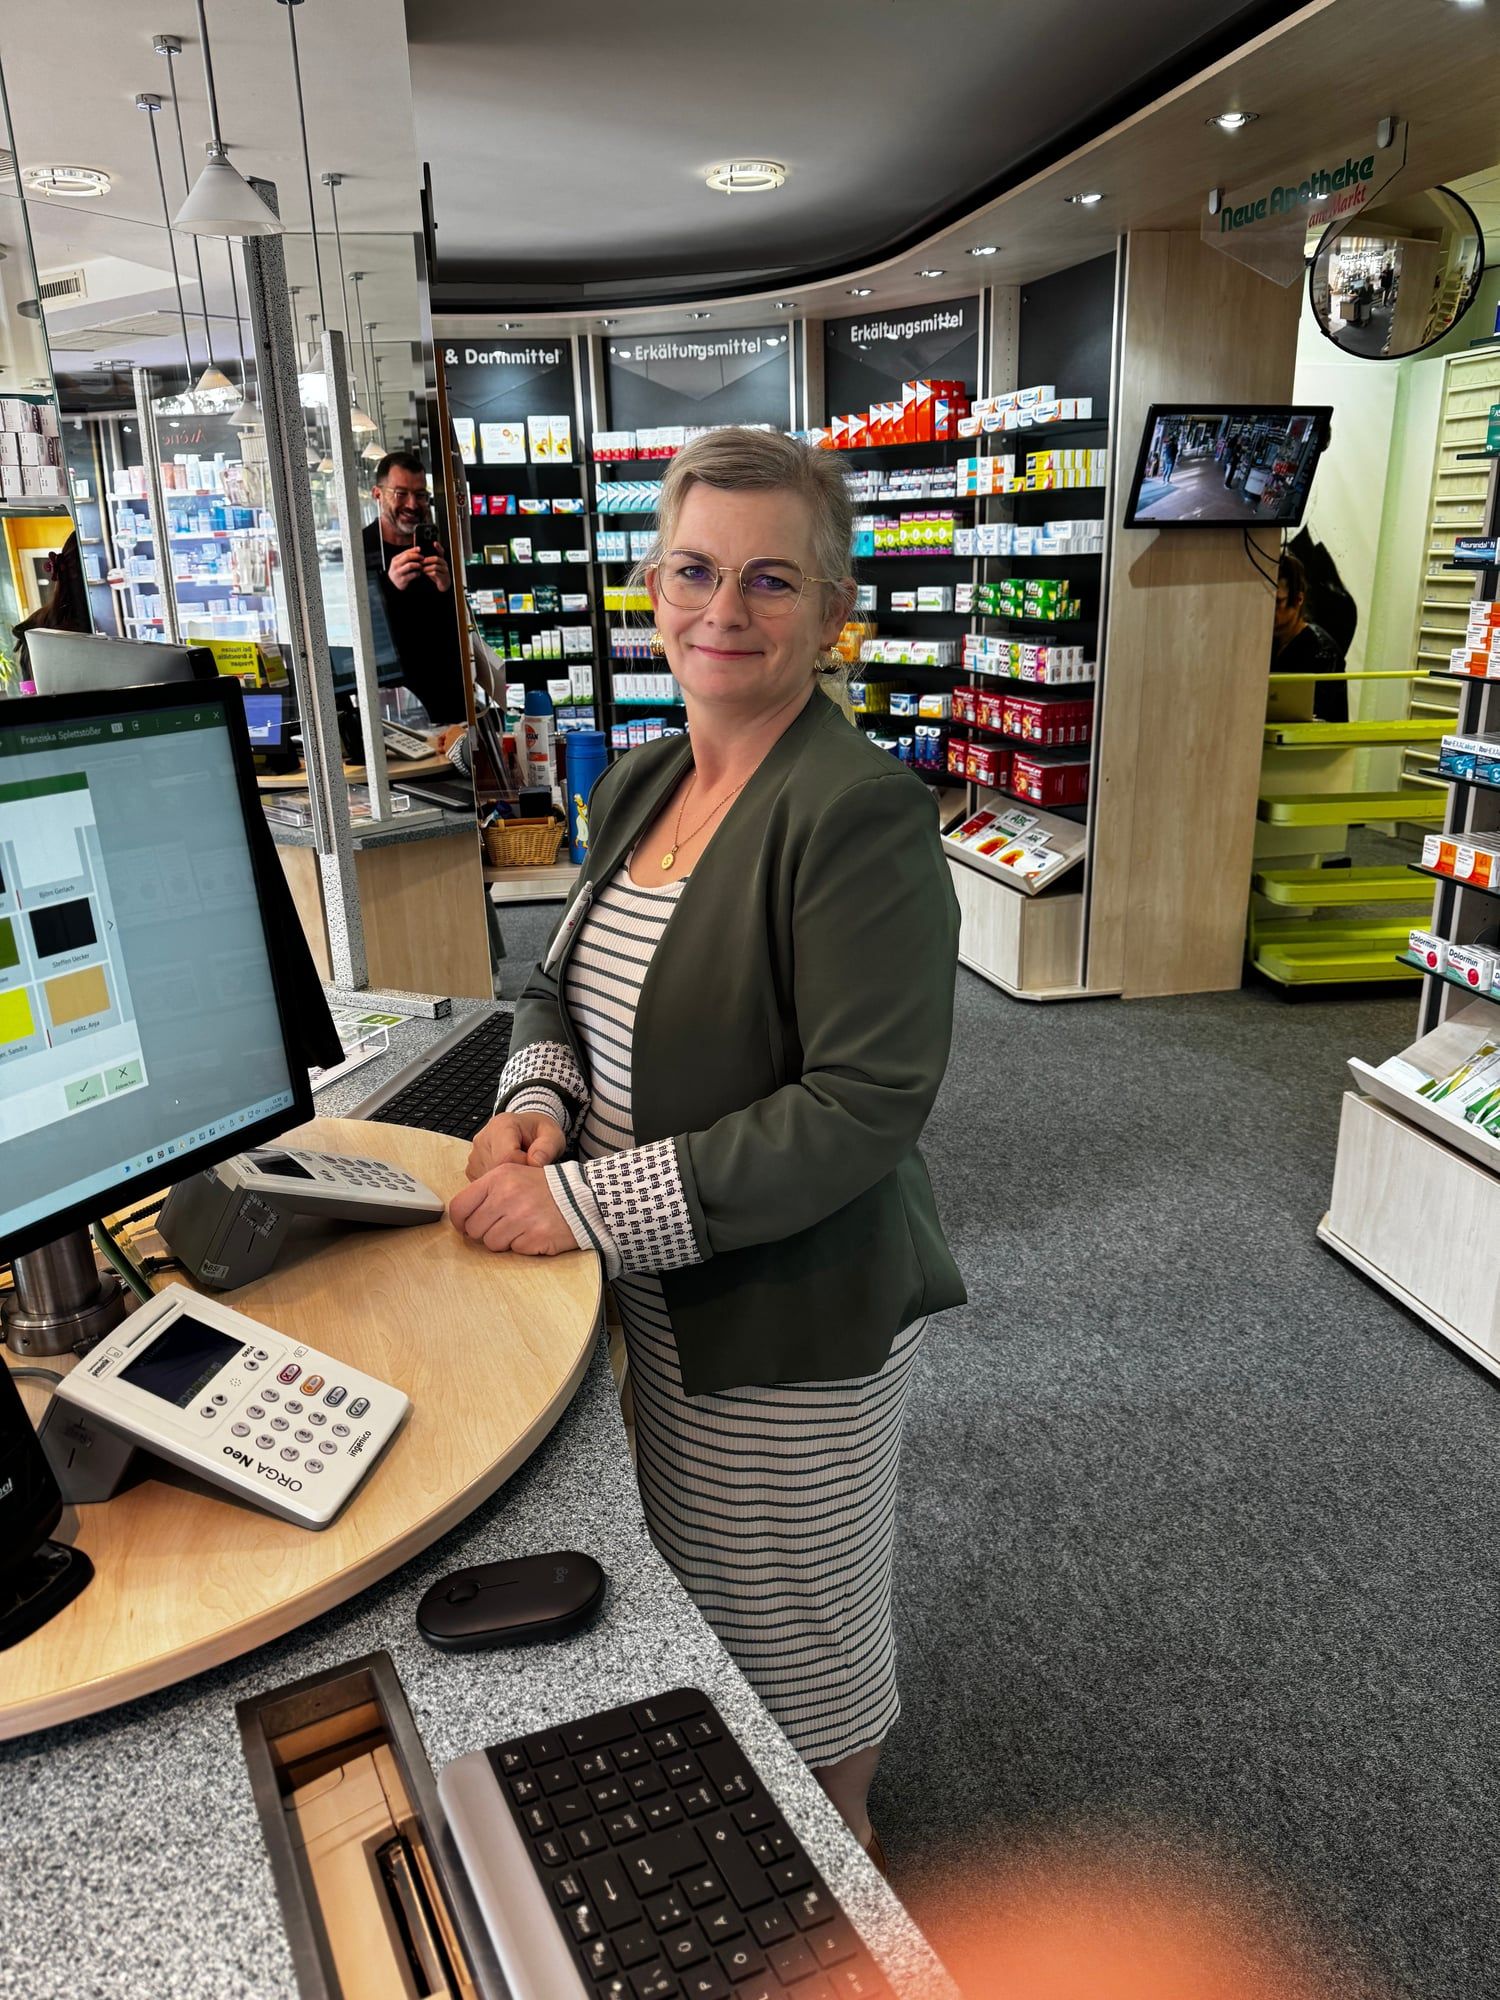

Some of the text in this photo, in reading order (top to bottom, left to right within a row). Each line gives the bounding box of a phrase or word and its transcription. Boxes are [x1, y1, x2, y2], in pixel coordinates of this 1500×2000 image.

[1221, 155, 1375, 233] Neue Apotheke
[1325, 184, 1367, 219] Markt
[850, 308, 964, 343] Erkältungsmittel
[445, 347, 562, 365] & Darmmittel
[635, 337, 762, 362] Erkältungsmittel
[1490, 541, 1496, 549] N
[20, 732, 57, 745] Franziska
[1410, 933, 1437, 950] Dolormin
[1449, 948, 1479, 967] Dolormin
[242, 1345, 256, 1358] ORGA
[349, 1430, 372, 1458] ingenico
[223, 1446, 303, 1492] ORGA Neo
